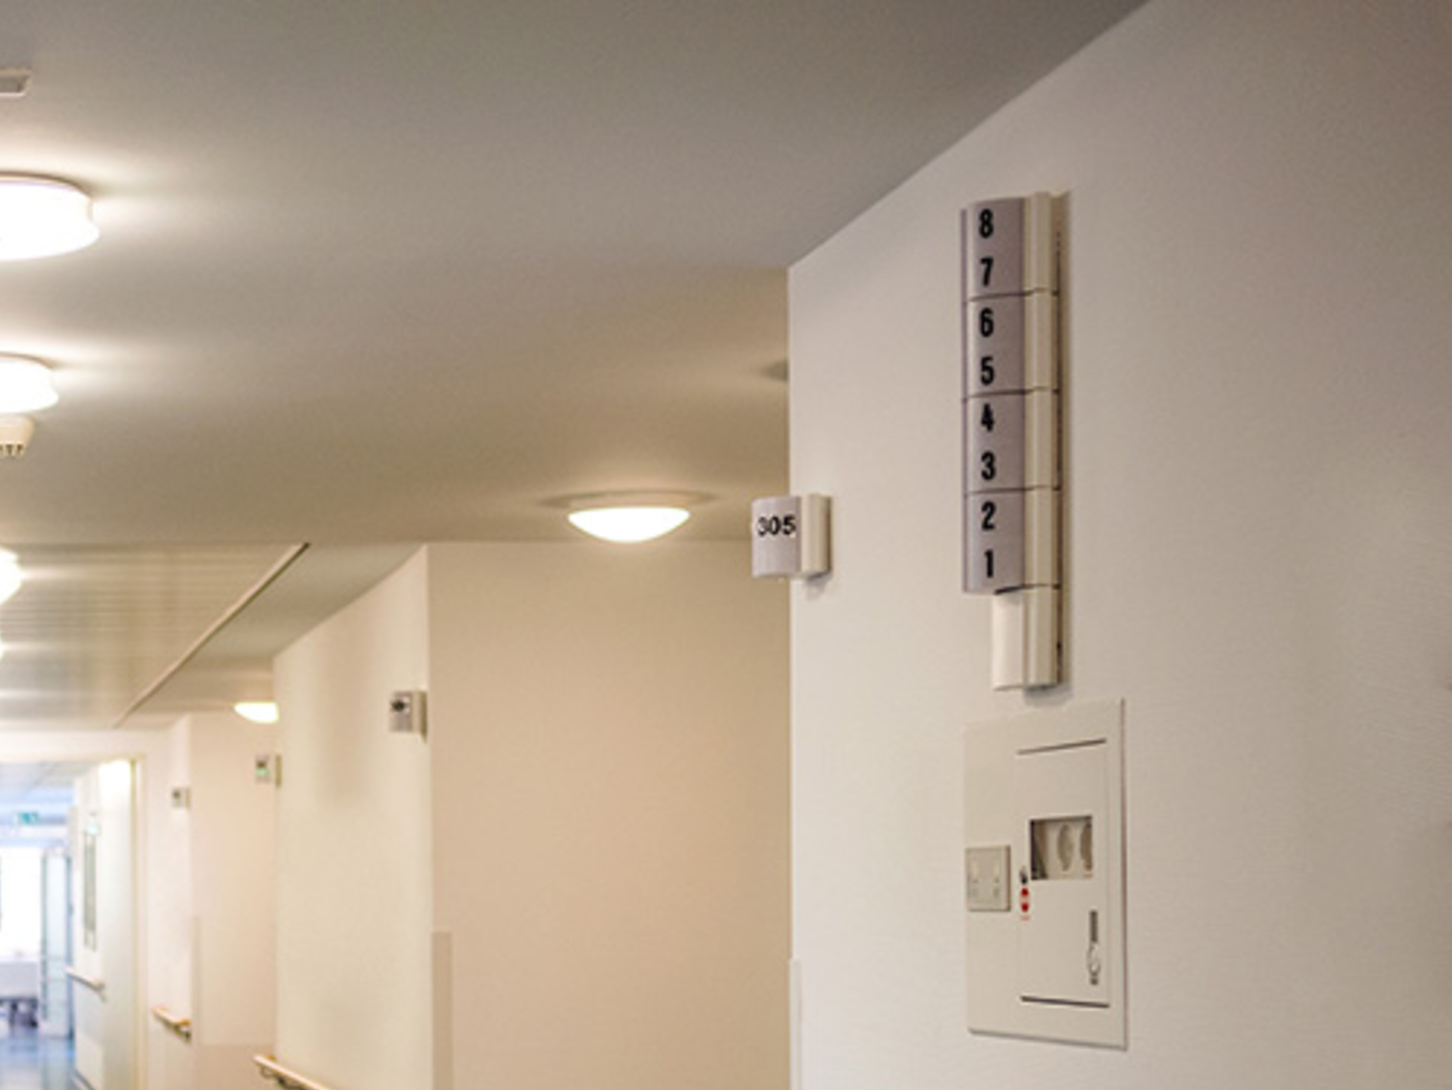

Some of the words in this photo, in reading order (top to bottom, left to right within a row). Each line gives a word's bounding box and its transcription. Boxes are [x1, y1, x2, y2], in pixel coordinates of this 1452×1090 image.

[978, 208, 994, 239] 8
[979, 256, 994, 287] 7
[979, 307, 994, 338] 6
[980, 356, 995, 387] 5
[980, 403, 995, 433] 4
[981, 451, 996, 481] 3
[757, 514, 797, 537] 305
[981, 501, 996, 531] 2
[984, 549, 995, 579] 1
